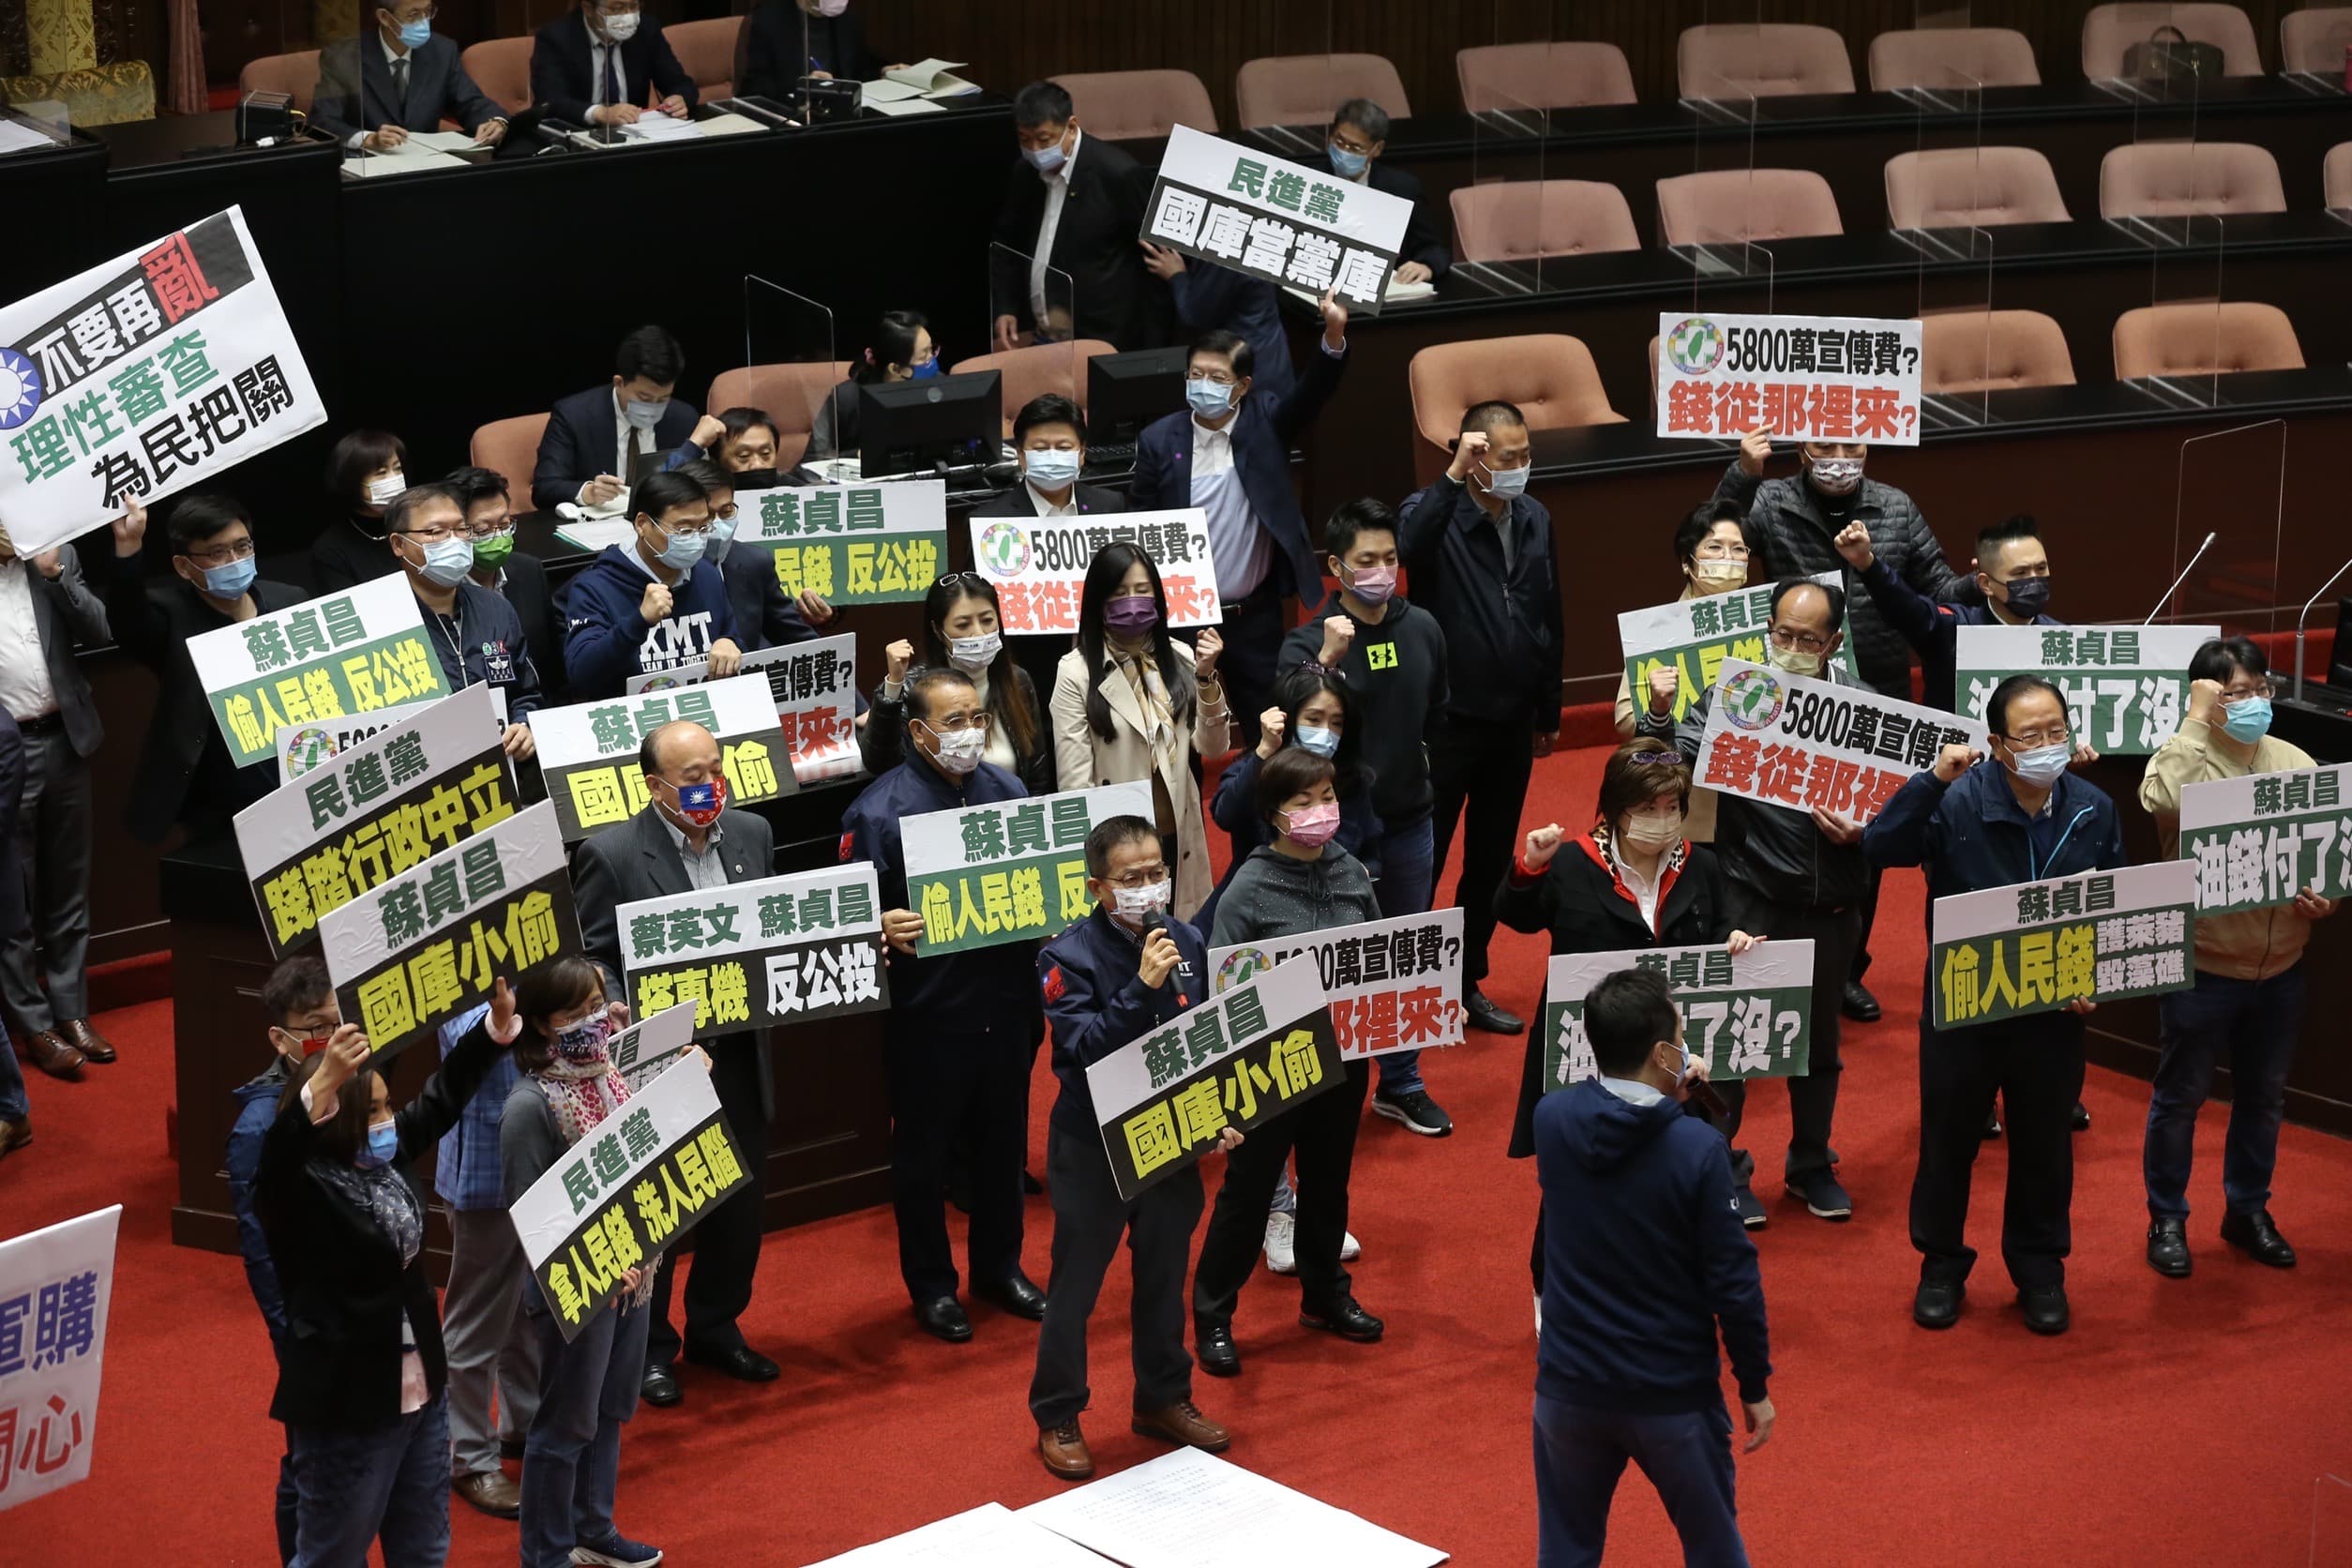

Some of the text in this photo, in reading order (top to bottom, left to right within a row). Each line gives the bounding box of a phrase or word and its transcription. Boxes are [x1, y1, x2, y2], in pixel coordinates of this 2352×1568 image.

[1228, 157, 1345, 224] 民進黨
[1150, 186, 1389, 304] 國庫當黨庫
[26, 231, 219, 395] 不要再亂
[1726, 328, 1919, 376] 5800萬宣傳費?
[9, 328, 219, 484] 理性審查
[91, 354, 294, 509] 為民把關
[1667, 380, 1916, 439] 錢從那裡來?
[760, 489, 884, 536] 蘇貞昌
[847, 539, 937, 595] 反公投
[241, 596, 368, 672] 蘇貞昌
[1690, 589, 1772, 638] 蘇貞昌
[2042, 630, 2140, 666] 蘇貞昌
[224, 668, 345, 754] 偷人民錢
[341, 638, 438, 713] 反公投
[667, 658, 677, 670] IN
[681, 652, 709, 668] TOGET
[588, 690, 721, 754] 蘇貞昌
[305, 730, 430, 831] 民進黨
[2254, 770, 2339, 816] 蘇貞昌
[263, 762, 515, 945] 踐踏行政中立
[959, 796, 1092, 863] 蘇貞昌
[378, 837, 505, 949] 蘇貞昌
[630, 882, 873, 959] 蔡英文 蘇貞昌
[921, 860, 1099, 944] 偷人民錢 反
[2017, 875, 2115, 924] 蘇貞昌
[357, 891, 559, 1052] 國庫小偷
[765, 942, 881, 1017] 反公投
[1941, 924, 2096, 1023] 偷人民錢
[1141, 985, 1268, 1089] 蘇貞昌
[1123, 1030, 1323, 1181] 國庫小偷
[561, 1106, 661, 1216] 民進黨
[549, 1123, 743, 1325] 拿人民錢 洗人民腦
